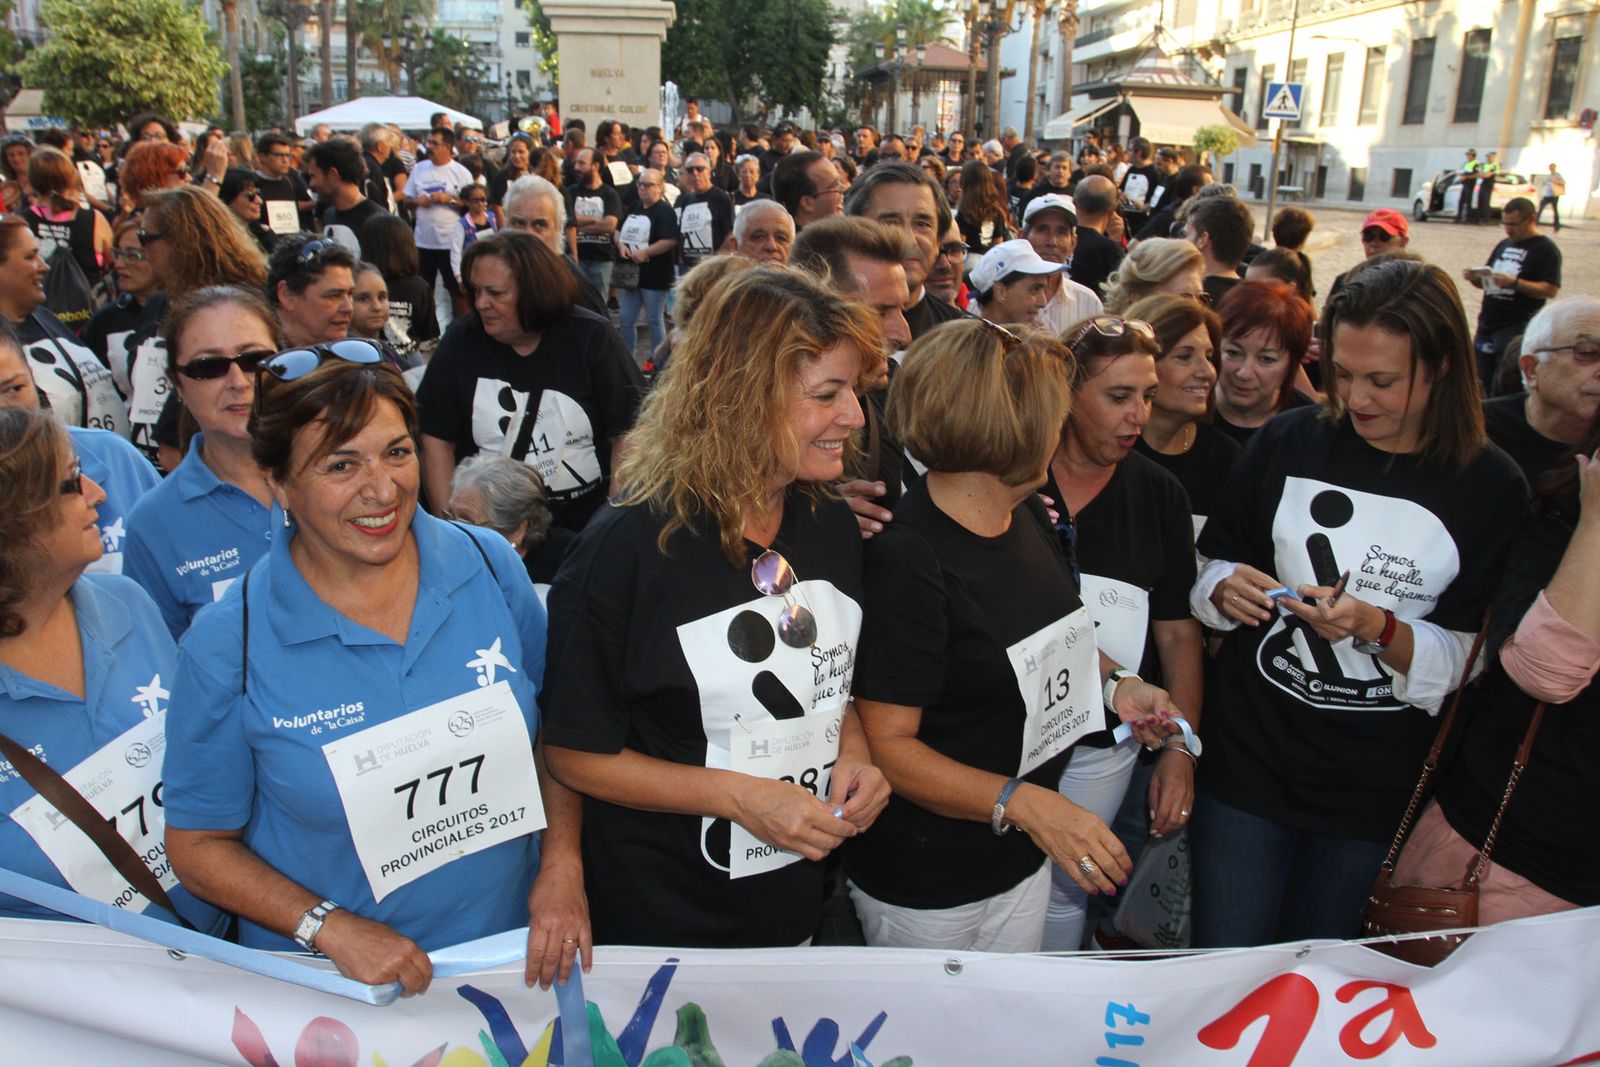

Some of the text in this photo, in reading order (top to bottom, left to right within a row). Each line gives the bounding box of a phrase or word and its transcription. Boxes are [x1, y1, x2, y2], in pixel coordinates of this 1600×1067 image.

[591, 68, 625, 78] HUELVA
[89, 415, 115, 431] 36
[526, 433, 555, 456] 41
[176, 547, 239, 577] Voluntarios
[1366, 545, 1416, 568] Somos
[1361, 559, 1424, 586] la huella
[1356, 578, 1437, 602] que dejamos
[811, 641, 849, 668] Somos
[812, 687, 836, 710] que
[1044, 668, 1070, 711] 13
[1324, 684, 1358, 695] ILUNION
[1377, 686, 1392, 695] ON
[272, 702, 365, 729] Voluntarios
[1072, 710, 1090, 729] 2017
[311, 725, 323, 736] de
[394, 739, 431, 759] HUELVA
[784, 740, 810, 753] HUELVA
[85, 778, 114, 800] UELVA
[394, 754, 485, 820] 777
[411, 804, 489, 844] CIRCUITOS
[380, 807, 527, 877] PROVINCIALES 2017
